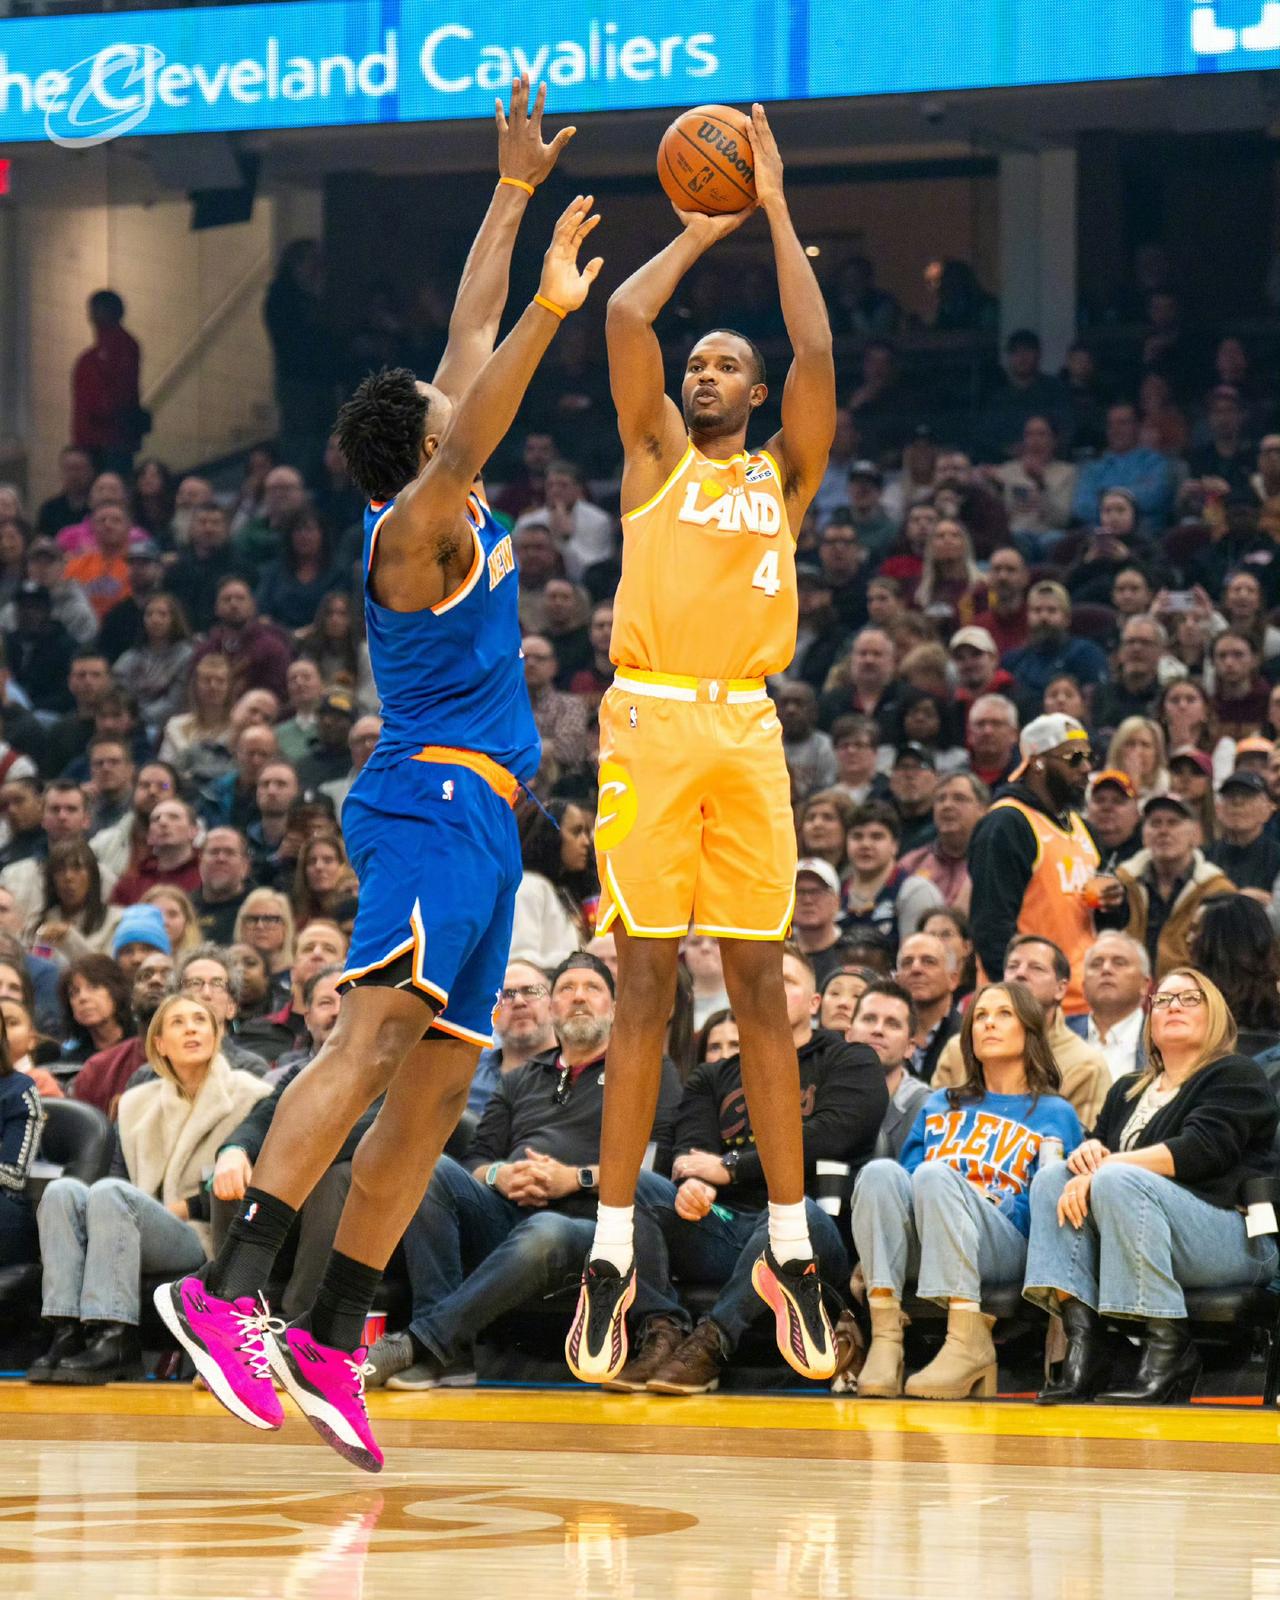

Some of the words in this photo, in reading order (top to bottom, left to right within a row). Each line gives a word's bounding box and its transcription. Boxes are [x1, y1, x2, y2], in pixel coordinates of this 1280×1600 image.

[91, 29, 399, 112] Cleveland
[419, 20, 719, 92] Cavaliers
[697, 120, 754, 184] Wilson
[678, 482, 781, 538] LAND
[487, 534, 515, 592] NEW
[752, 550, 781, 598] 4
